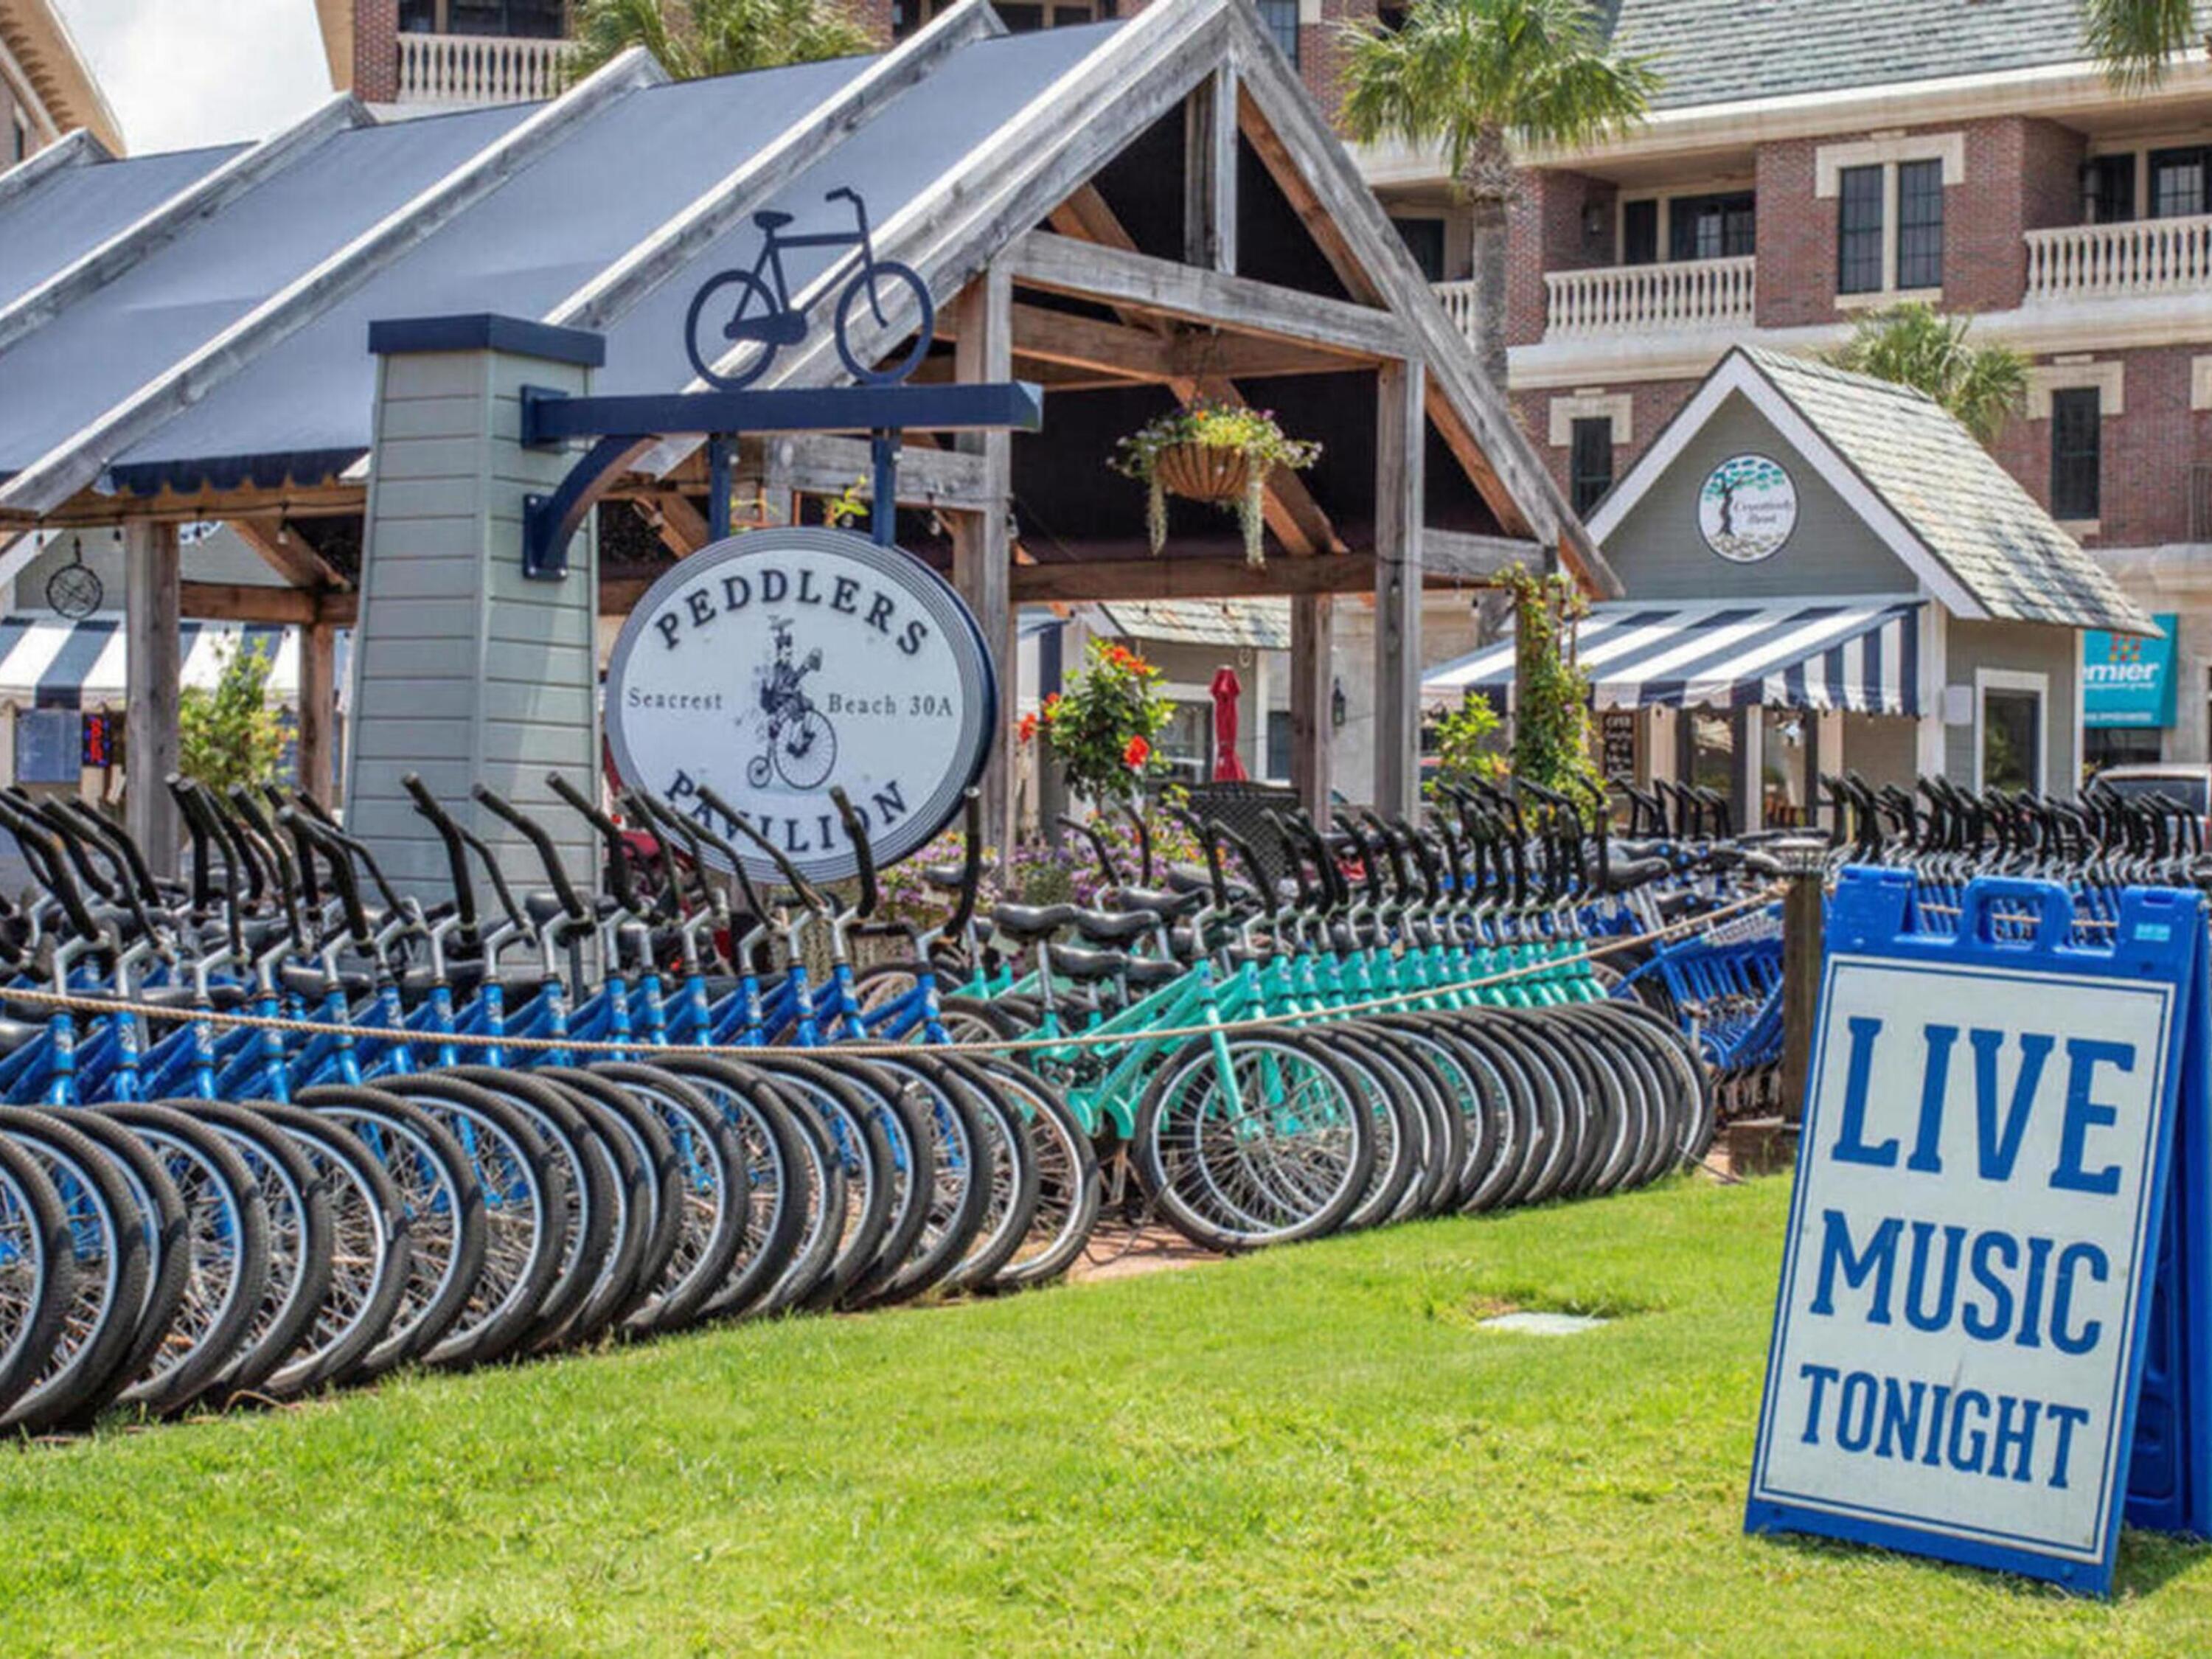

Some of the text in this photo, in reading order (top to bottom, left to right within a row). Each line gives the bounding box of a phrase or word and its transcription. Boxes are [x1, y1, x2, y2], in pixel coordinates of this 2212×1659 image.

[656, 569, 928, 655] PEDDLERS
[628, 689, 953, 717] Seacrest Beach 30A
[1832, 1017, 2136, 1194] LIVE
[1809, 1208, 2109, 1355] MUSIC
[1800, 1363, 2088, 1488] TONIGHT
